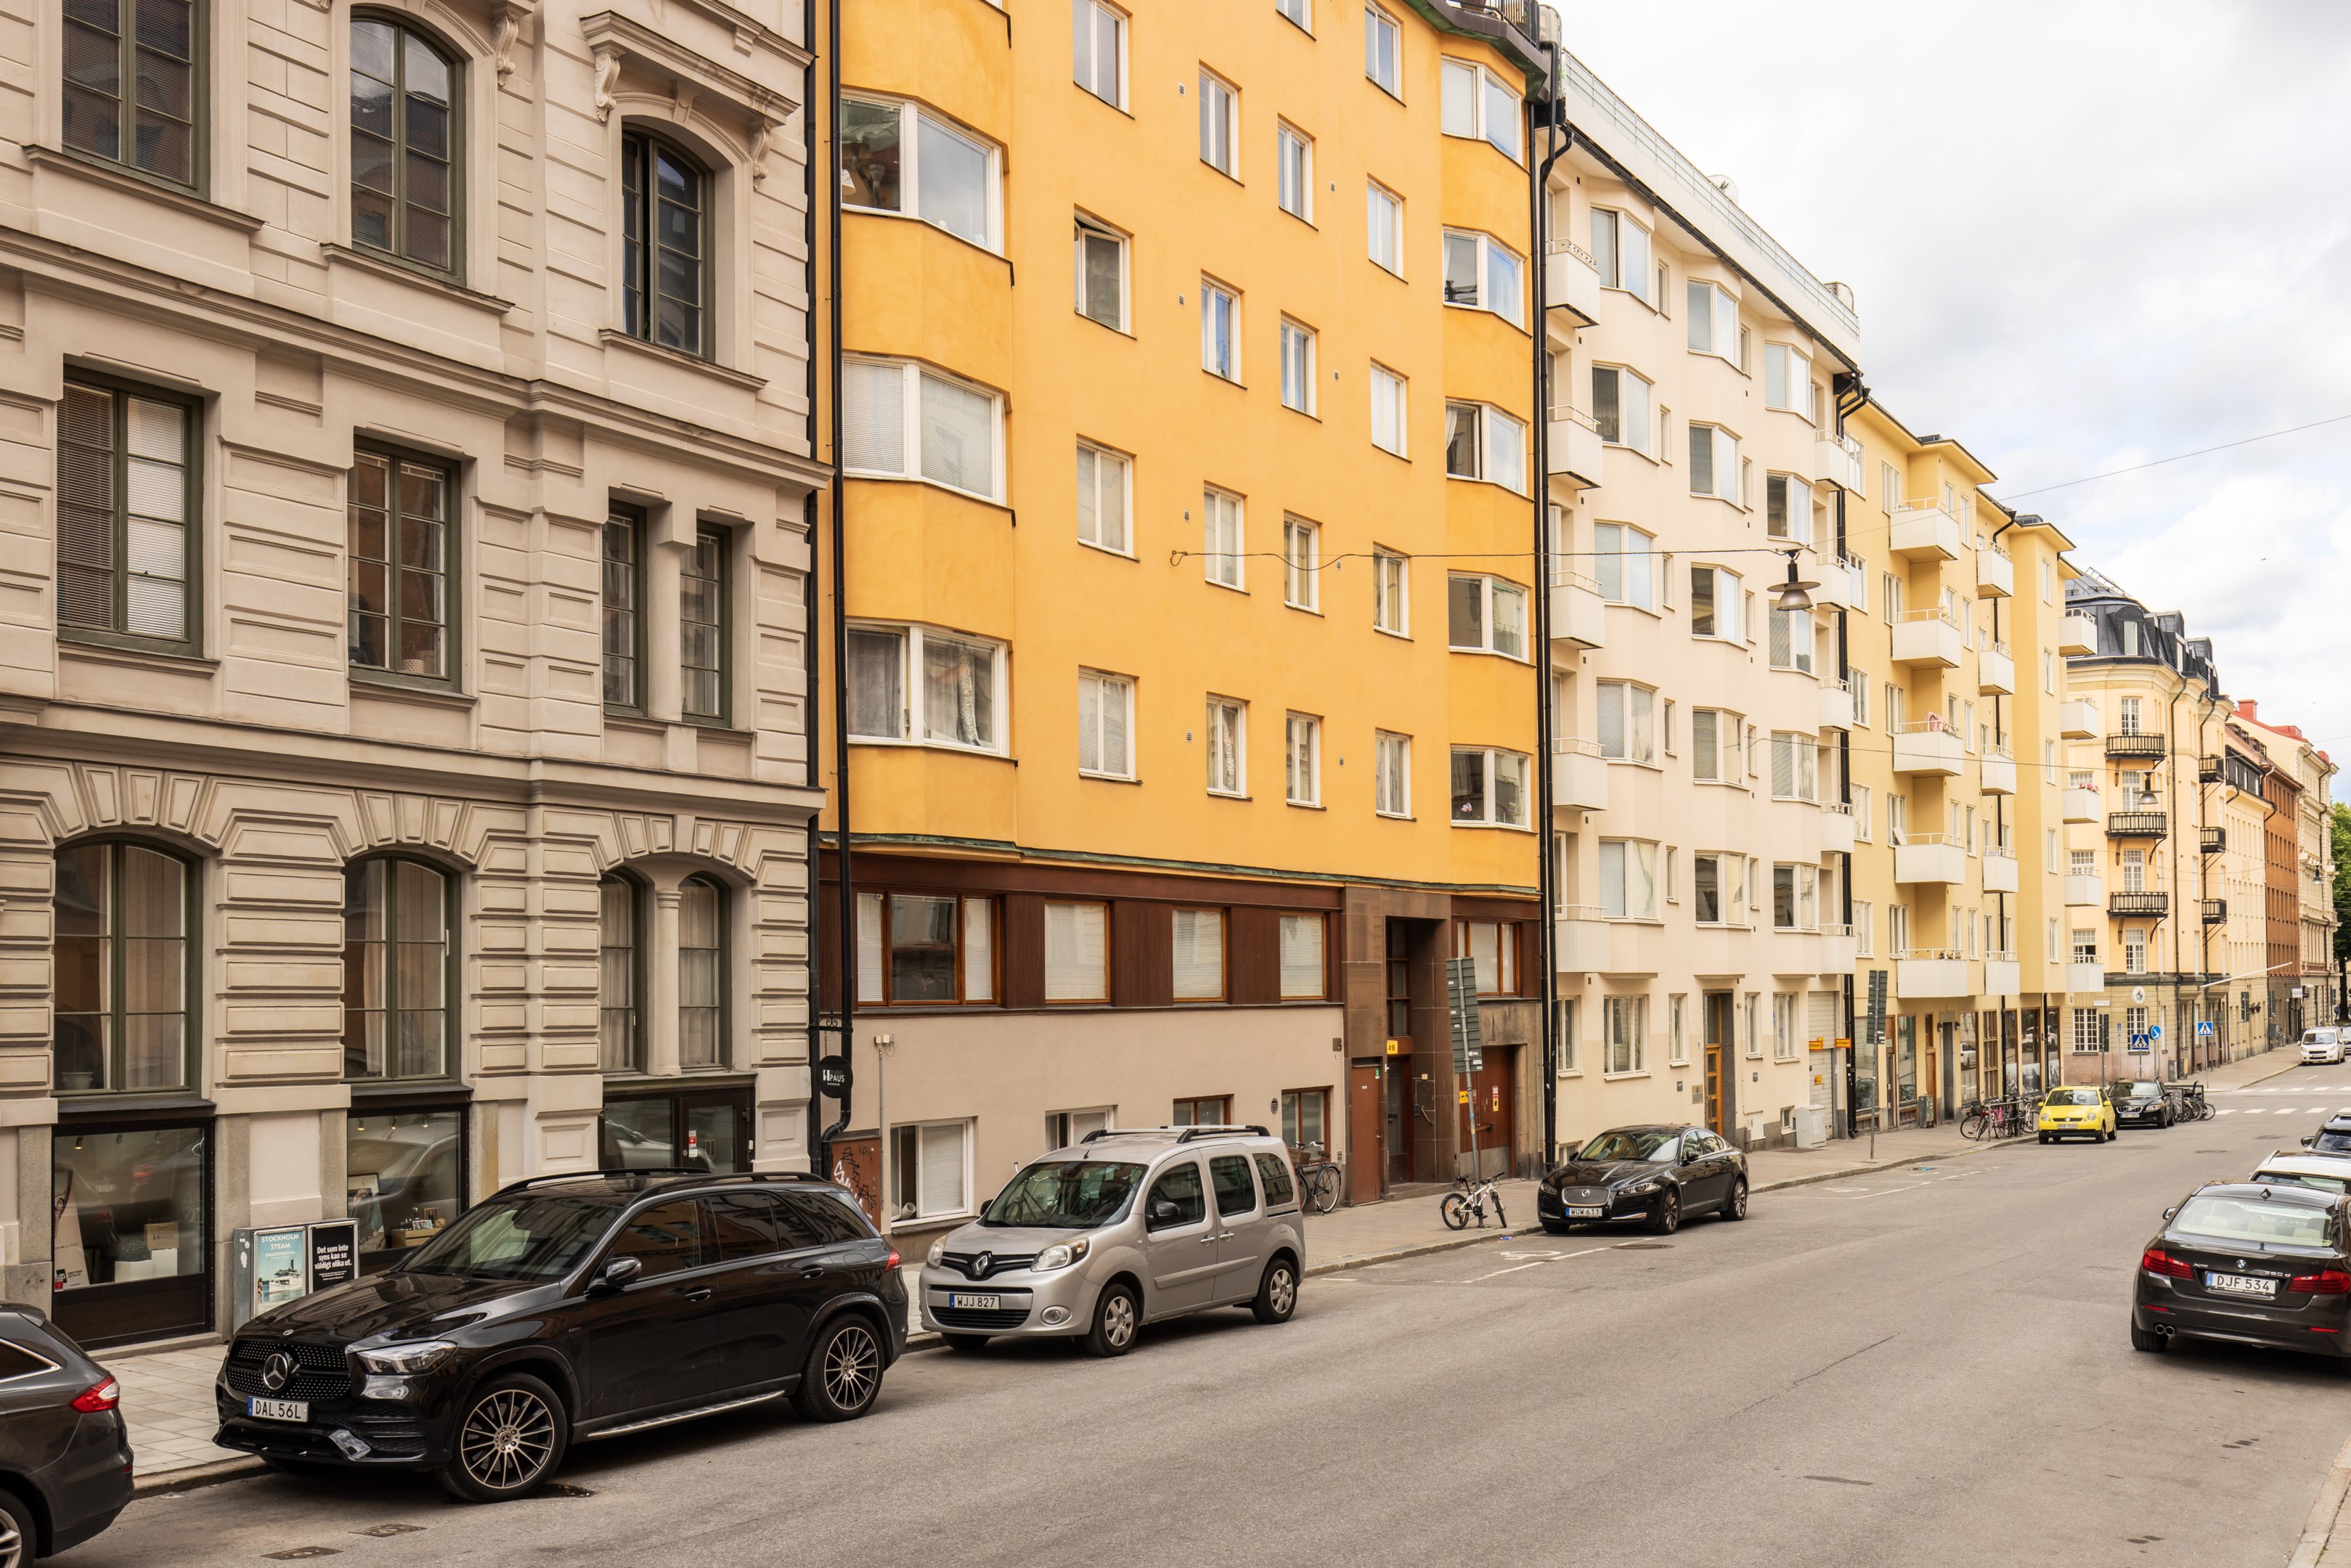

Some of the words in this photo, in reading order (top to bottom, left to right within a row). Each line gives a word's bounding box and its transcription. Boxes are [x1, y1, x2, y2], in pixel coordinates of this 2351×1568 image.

[261, 1234, 299, 1243] STOCKHOLM
[314, 1261, 331, 1270] väldigt
[2217, 1275, 2241, 1288] DJF
[2245, 1278, 2270, 1291] 534
[957, 1296, 974, 1307] WJJ
[977, 1297, 995, 1307] 827
[256, 1400, 274, 1417] DAL
[278, 1403, 301, 1419] 56L
